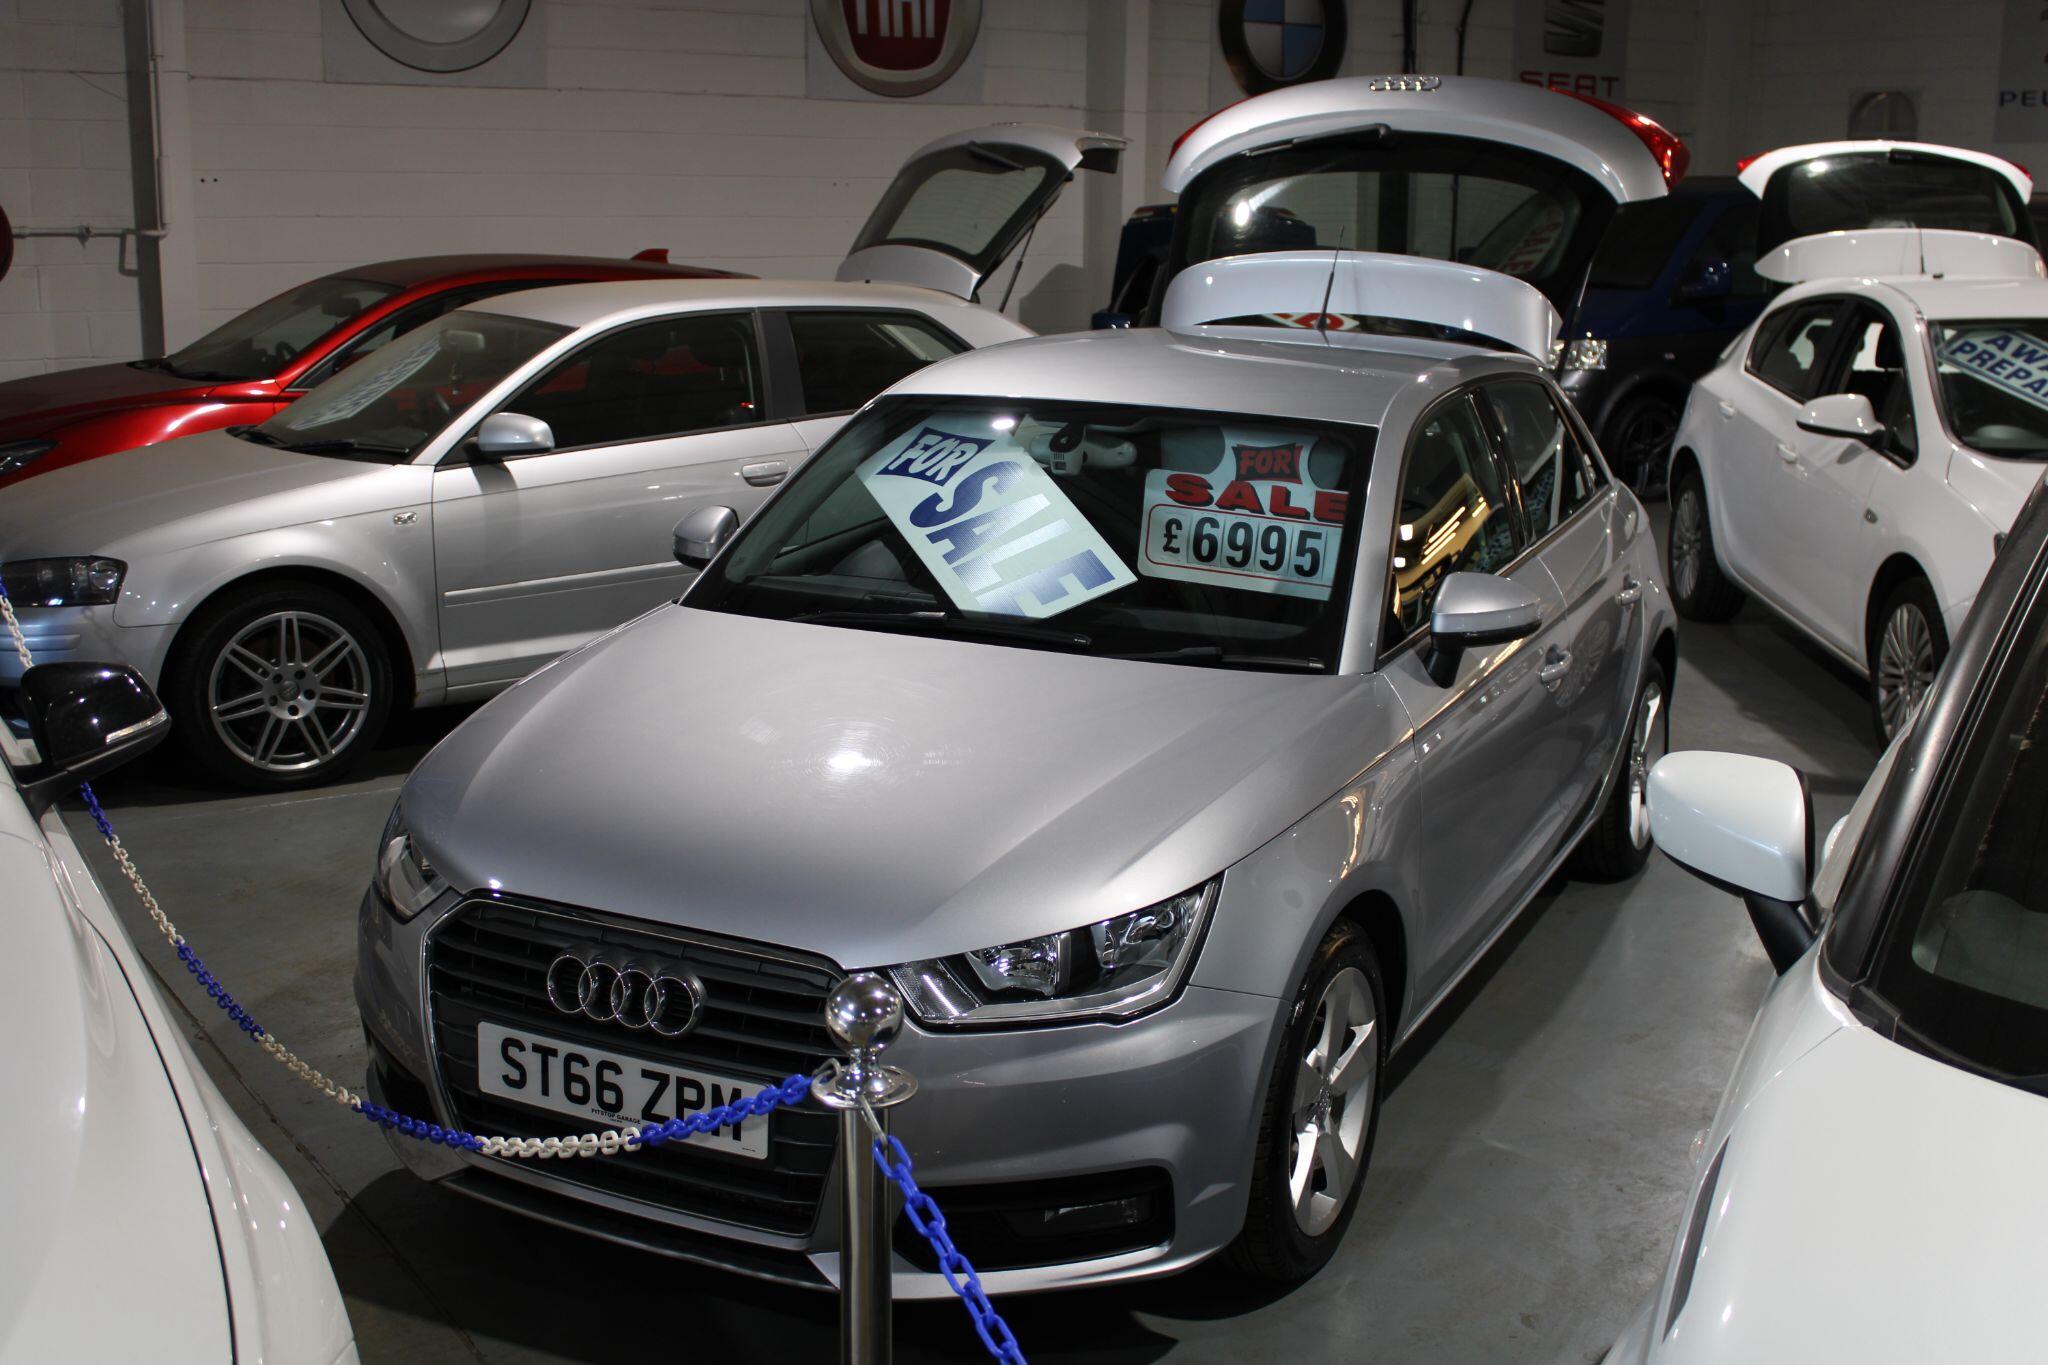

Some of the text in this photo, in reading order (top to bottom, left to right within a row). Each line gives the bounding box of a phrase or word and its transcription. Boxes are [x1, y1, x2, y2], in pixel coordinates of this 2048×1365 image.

[1520, 70, 1620, 98] SEAT
[1949, 340, 2048, 398] PREPA
[887, 433, 979, 482] FOR
[1239, 449, 1292, 476] FOR
[1165, 473, 1348, 524] SALE
[909, 460, 1117, 617] SALE
[1162, 516, 1323, 578] £6995
[500, 1036, 624, 1114] ST66
